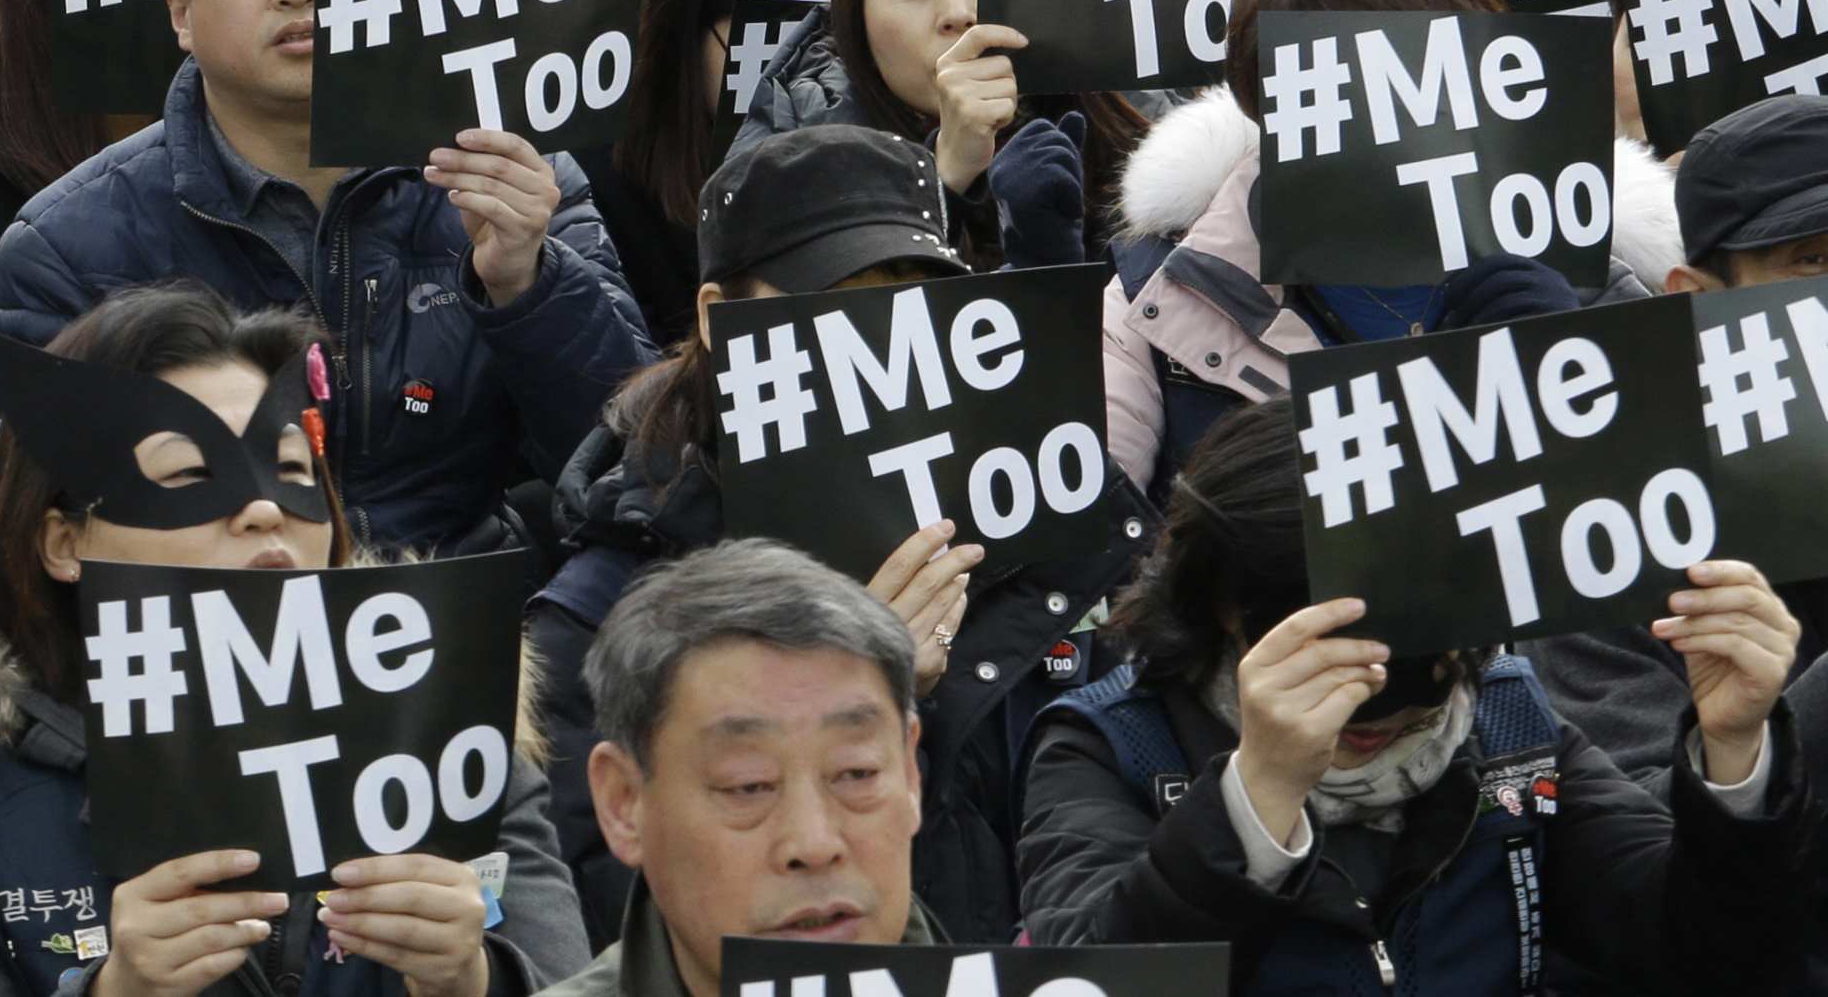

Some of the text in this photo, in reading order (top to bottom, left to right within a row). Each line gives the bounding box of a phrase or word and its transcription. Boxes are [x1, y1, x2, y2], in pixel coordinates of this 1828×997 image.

[442, 30, 632, 132] Too
[1262, 16, 1548, 162] #Me
[1396, 152, 1610, 272] Too
[430, 291, 460, 307] NEP
[403, 384, 434, 402] #Me
[404, 396, 429, 414] Too
[717, 286, 1025, 464] #Me
[1298, 327, 1618, 529] #Me
[867, 422, 1104, 563] Too
[1456, 468, 1716, 628] Too
[85, 574, 435, 737] #Me
[1043, 657, 1073, 673] Too
[239, 724, 508, 878] Too
